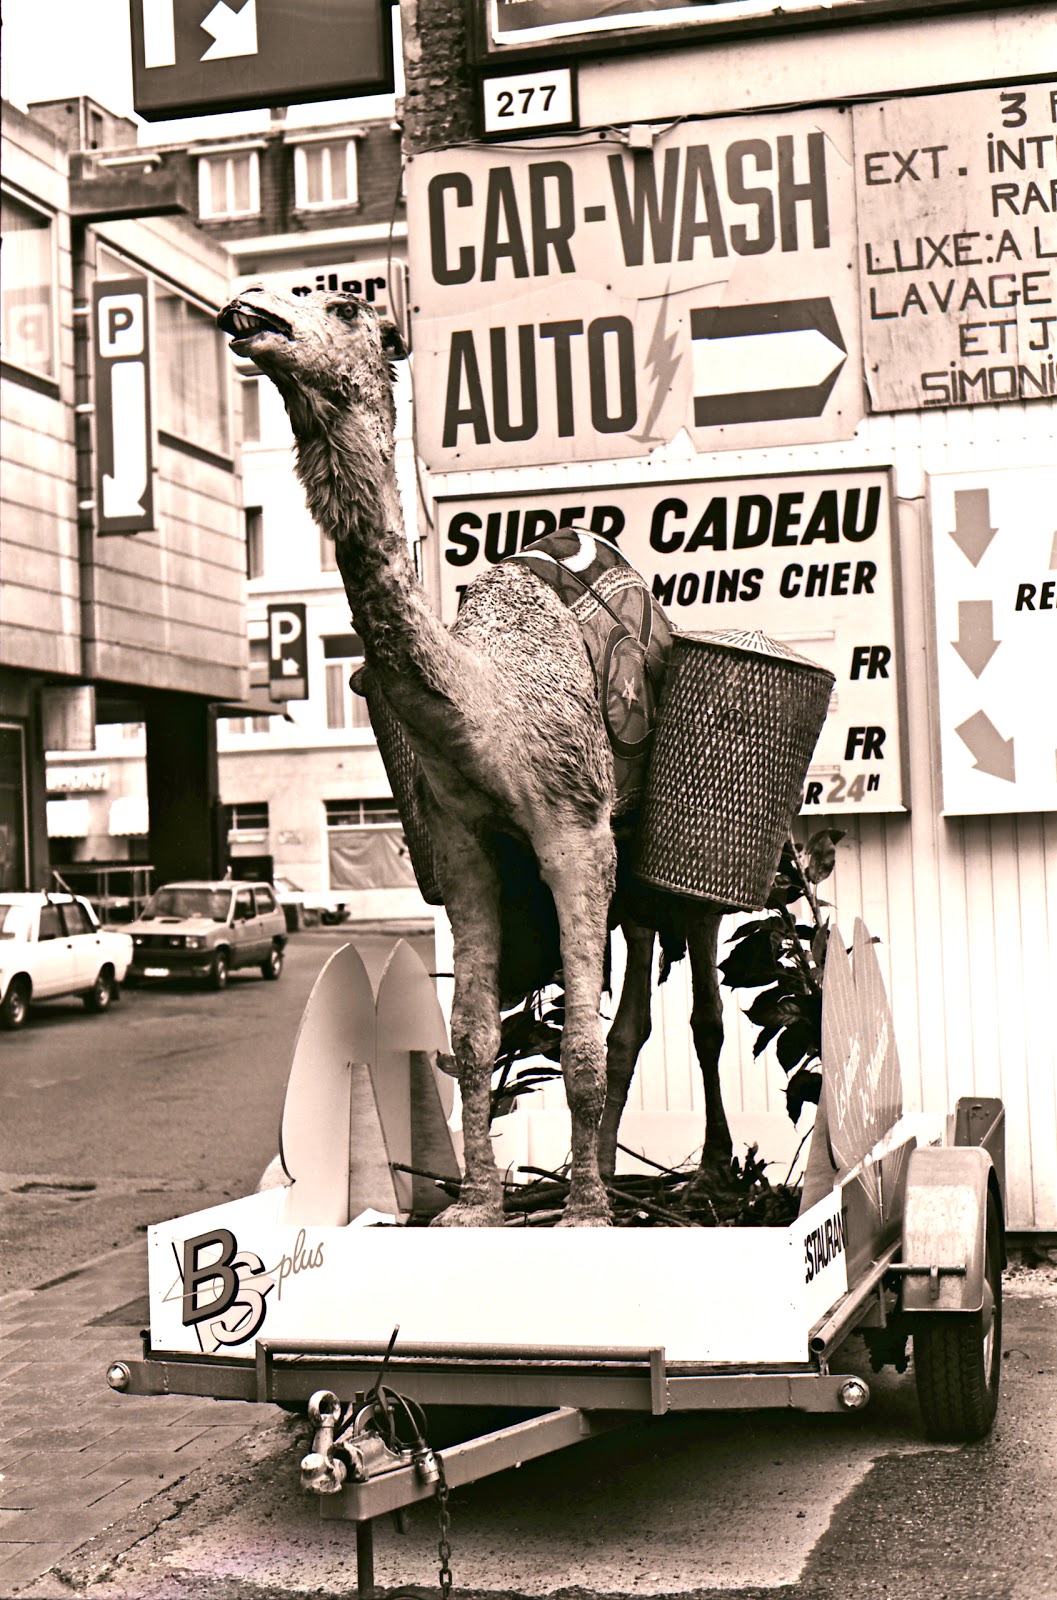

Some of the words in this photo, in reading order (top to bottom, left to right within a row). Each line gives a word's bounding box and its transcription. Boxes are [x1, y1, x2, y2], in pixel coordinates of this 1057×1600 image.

[496, 84, 557, 118] 277
[1000, 92, 1027, 128] 3
[864, 145, 968, 186] EXT.
[428, 132, 831, 287] CAR-WASH
[869, 270, 1053, 320] LAVAGE
[107, 306, 134, 345] P
[959, 319, 1018, 357] ET
[441, 315, 638, 448] AUTO
[649, 486, 882, 554] CADEAU
[652, 567, 764, 607] MOINS
[779, 560, 878, 599] CHER
[271, 611, 302, 661] P
[850, 645, 892, 681] FR
[844, 726, 887, 761] FR
[276, 1228, 326, 1301] plus
[804, 1205, 850, 1285] STAURANT
